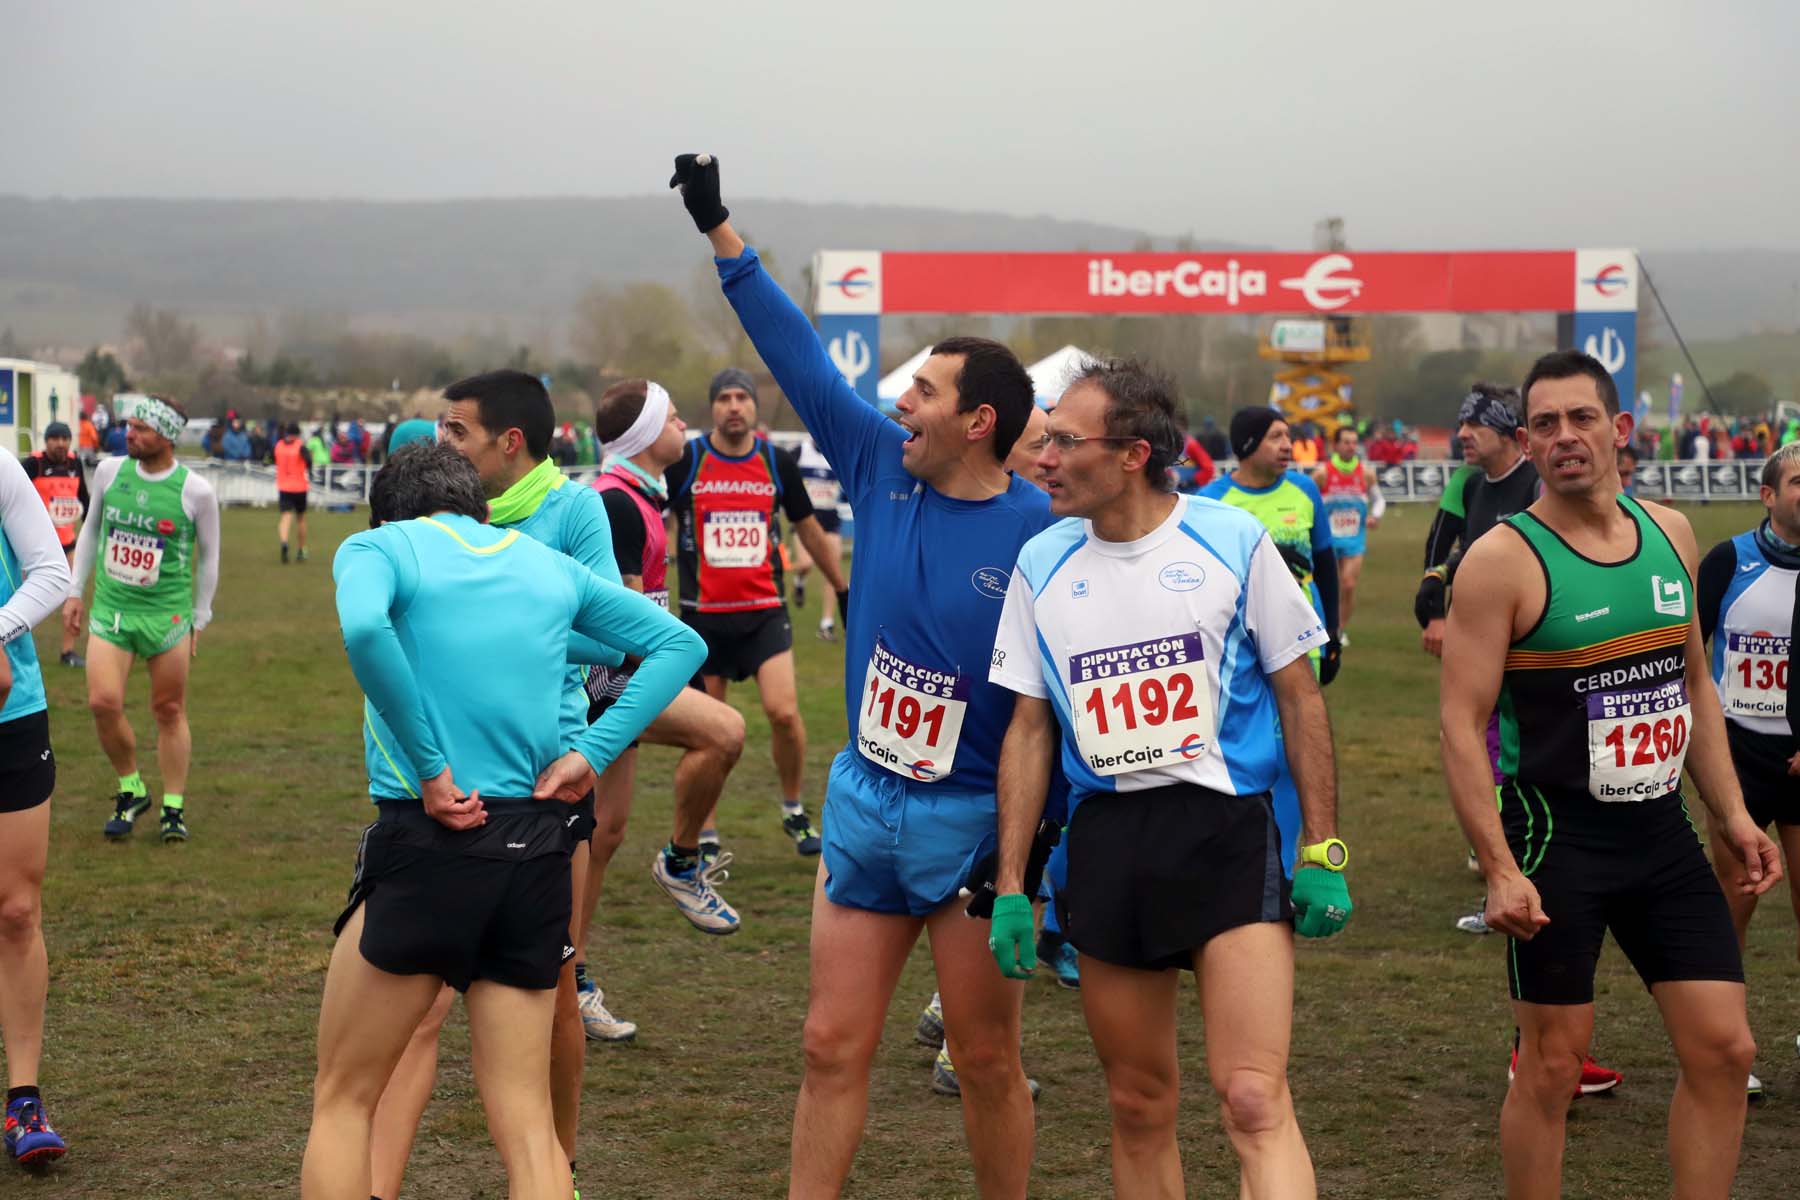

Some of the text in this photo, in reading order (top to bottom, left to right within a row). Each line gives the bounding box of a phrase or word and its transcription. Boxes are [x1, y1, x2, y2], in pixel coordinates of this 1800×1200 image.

[1088, 259, 1267, 305] iberCaja
[690, 479, 777, 496] CAMARGO
[712, 526, 760, 548] 1320
[112, 543, 155, 570] 1399
[875, 642, 956, 687] DIPUTACIÓN
[1081, 639, 1185, 668] DIPUTACIÓN
[1081, 651, 1187, 680] BURGOS
[873, 654, 954, 699] BURGOS
[1086, 672, 1199, 735] 1192
[1602, 683, 1681, 706] DIPUTACIÓN
[1604, 694, 1683, 718] BURGOS
[1732, 698, 1785, 713] iberCaja
[867, 675, 946, 748] 1191
[1605, 714, 1687, 768] 1260
[1090, 746, 1164, 769] iberCaja
[1599, 780, 1660, 796] iberCaja
